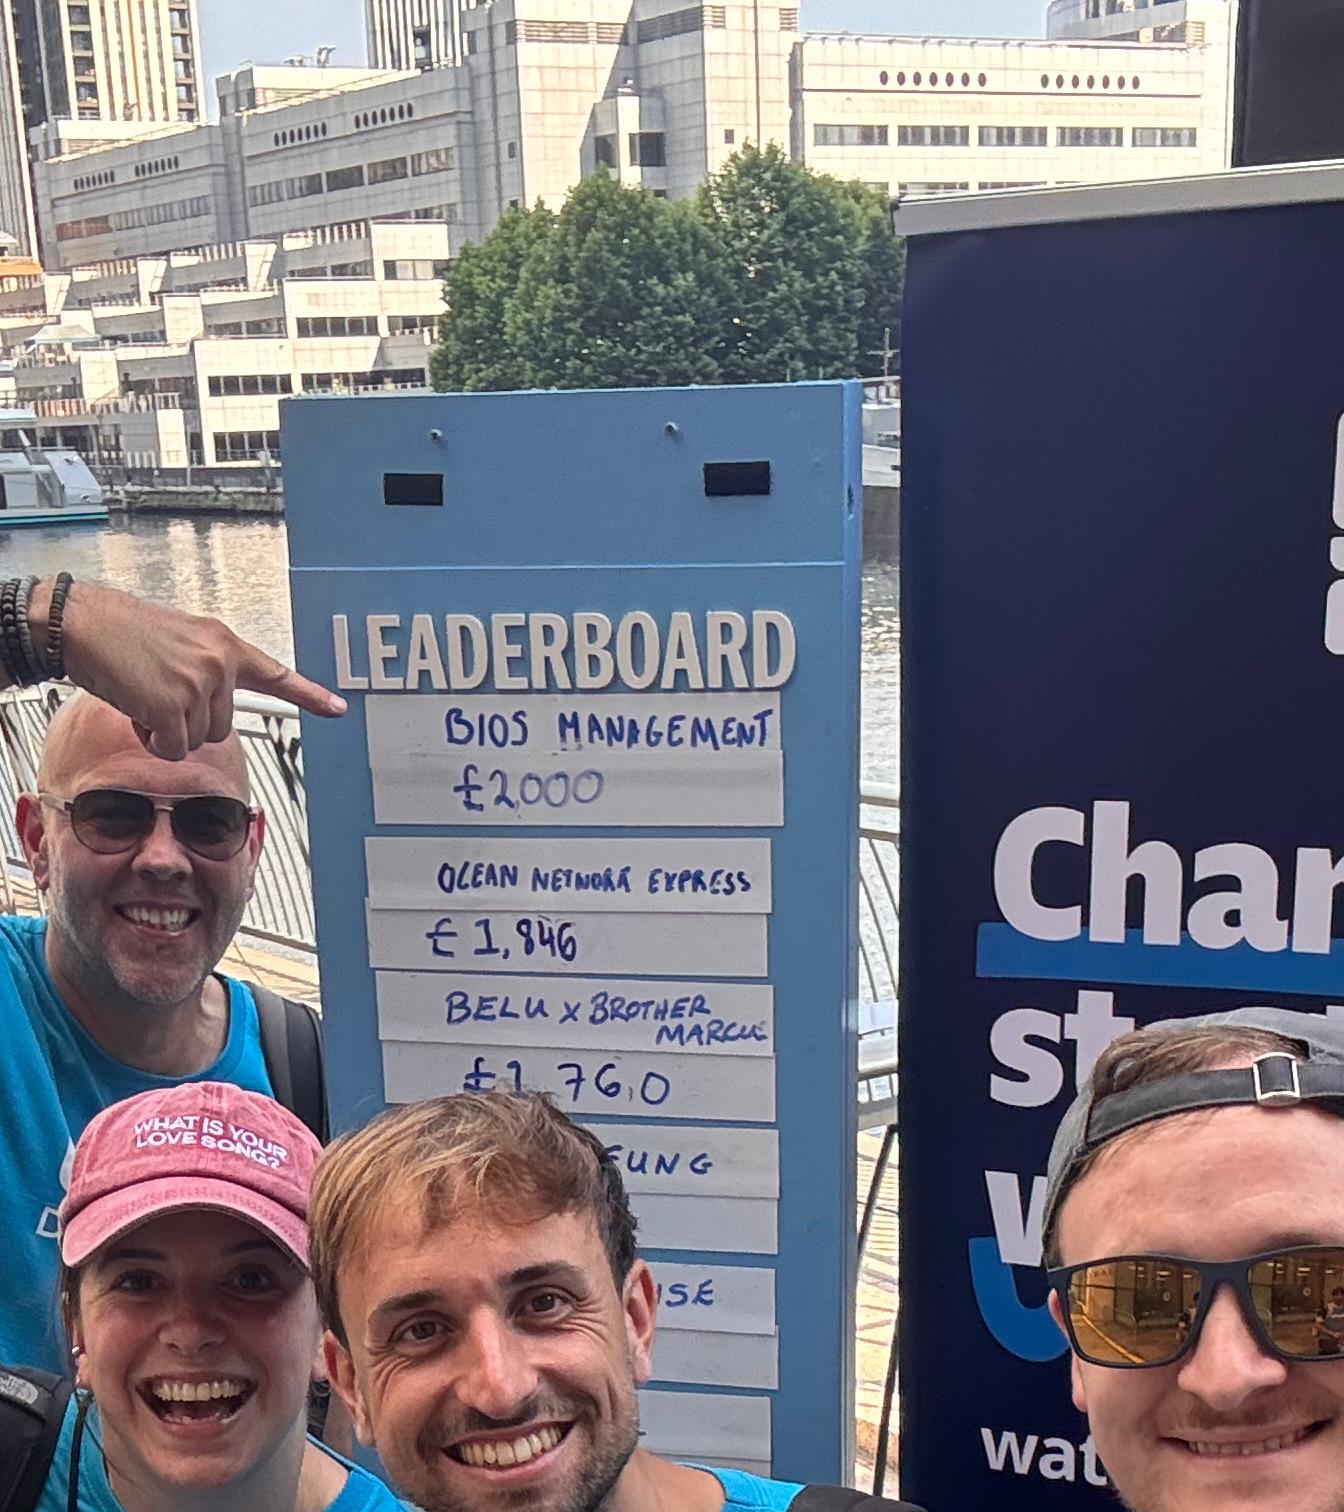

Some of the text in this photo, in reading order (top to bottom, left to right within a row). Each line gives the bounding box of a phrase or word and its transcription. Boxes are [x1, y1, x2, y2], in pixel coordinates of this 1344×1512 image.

[332, 611, 796, 691] LEADERBOARD
[445, 707, 774, 751] BIOS MANAGEMENT
[647, 868, 753, 896] EXPRESS
[446, 990, 549, 1025] BELU
[589, 992, 711, 1026] BROTHER
[133, 1115, 288, 1160] WHAT IS YOUR
[135, 1131, 280, 1170] LOVE SONG?
